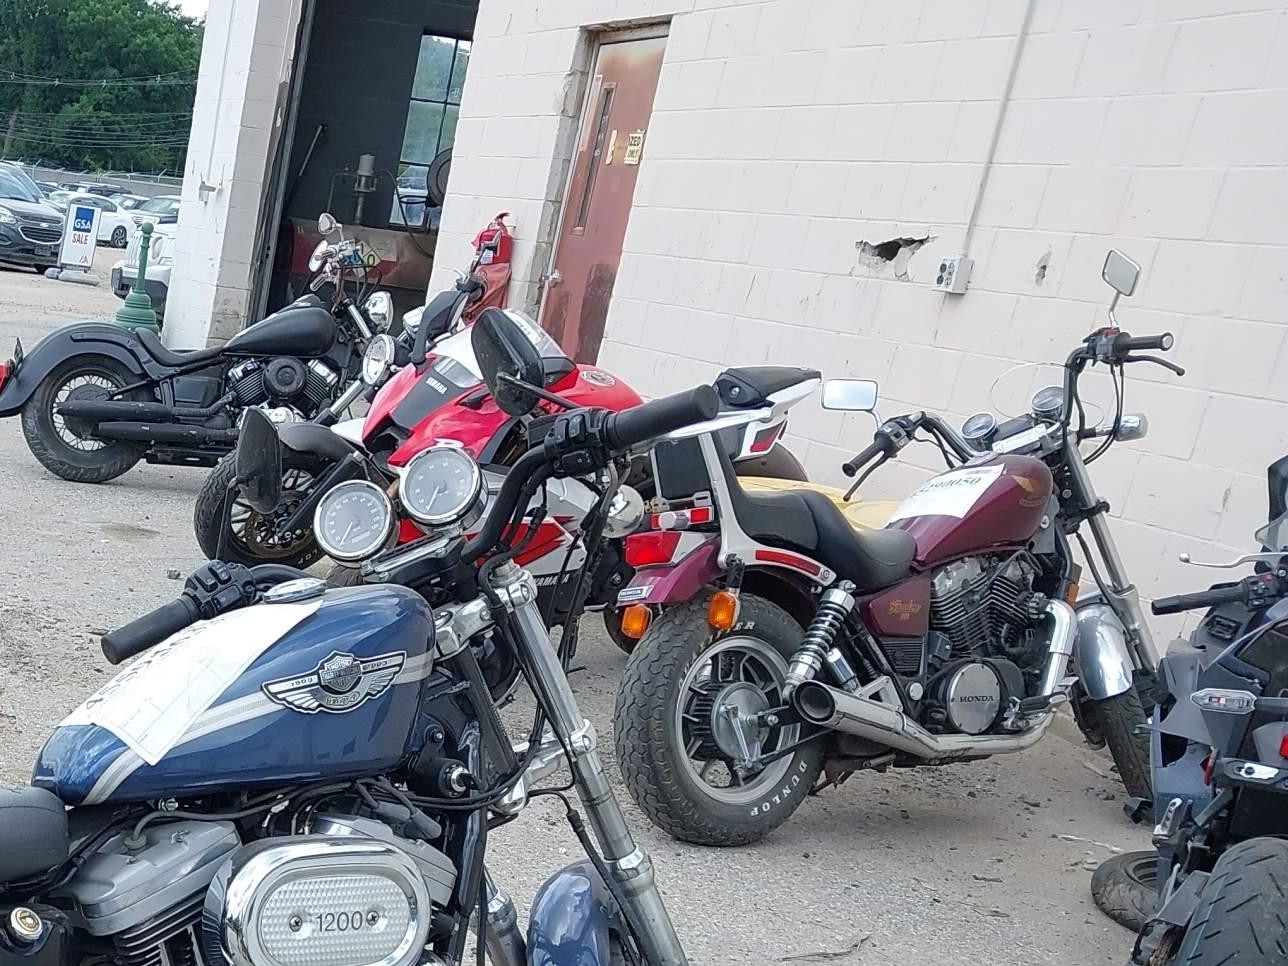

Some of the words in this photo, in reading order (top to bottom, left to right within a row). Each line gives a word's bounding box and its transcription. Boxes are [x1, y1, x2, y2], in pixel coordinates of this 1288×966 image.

[74, 218, 91, 230] GSA
[72, 233, 89, 245] SALE
[533, 573, 570, 588] YAMAA
[959, 695, 994, 703] HONDA
[750, 760, 808, 817] DUNLOP
[315, 910, 363, 932] 1200
